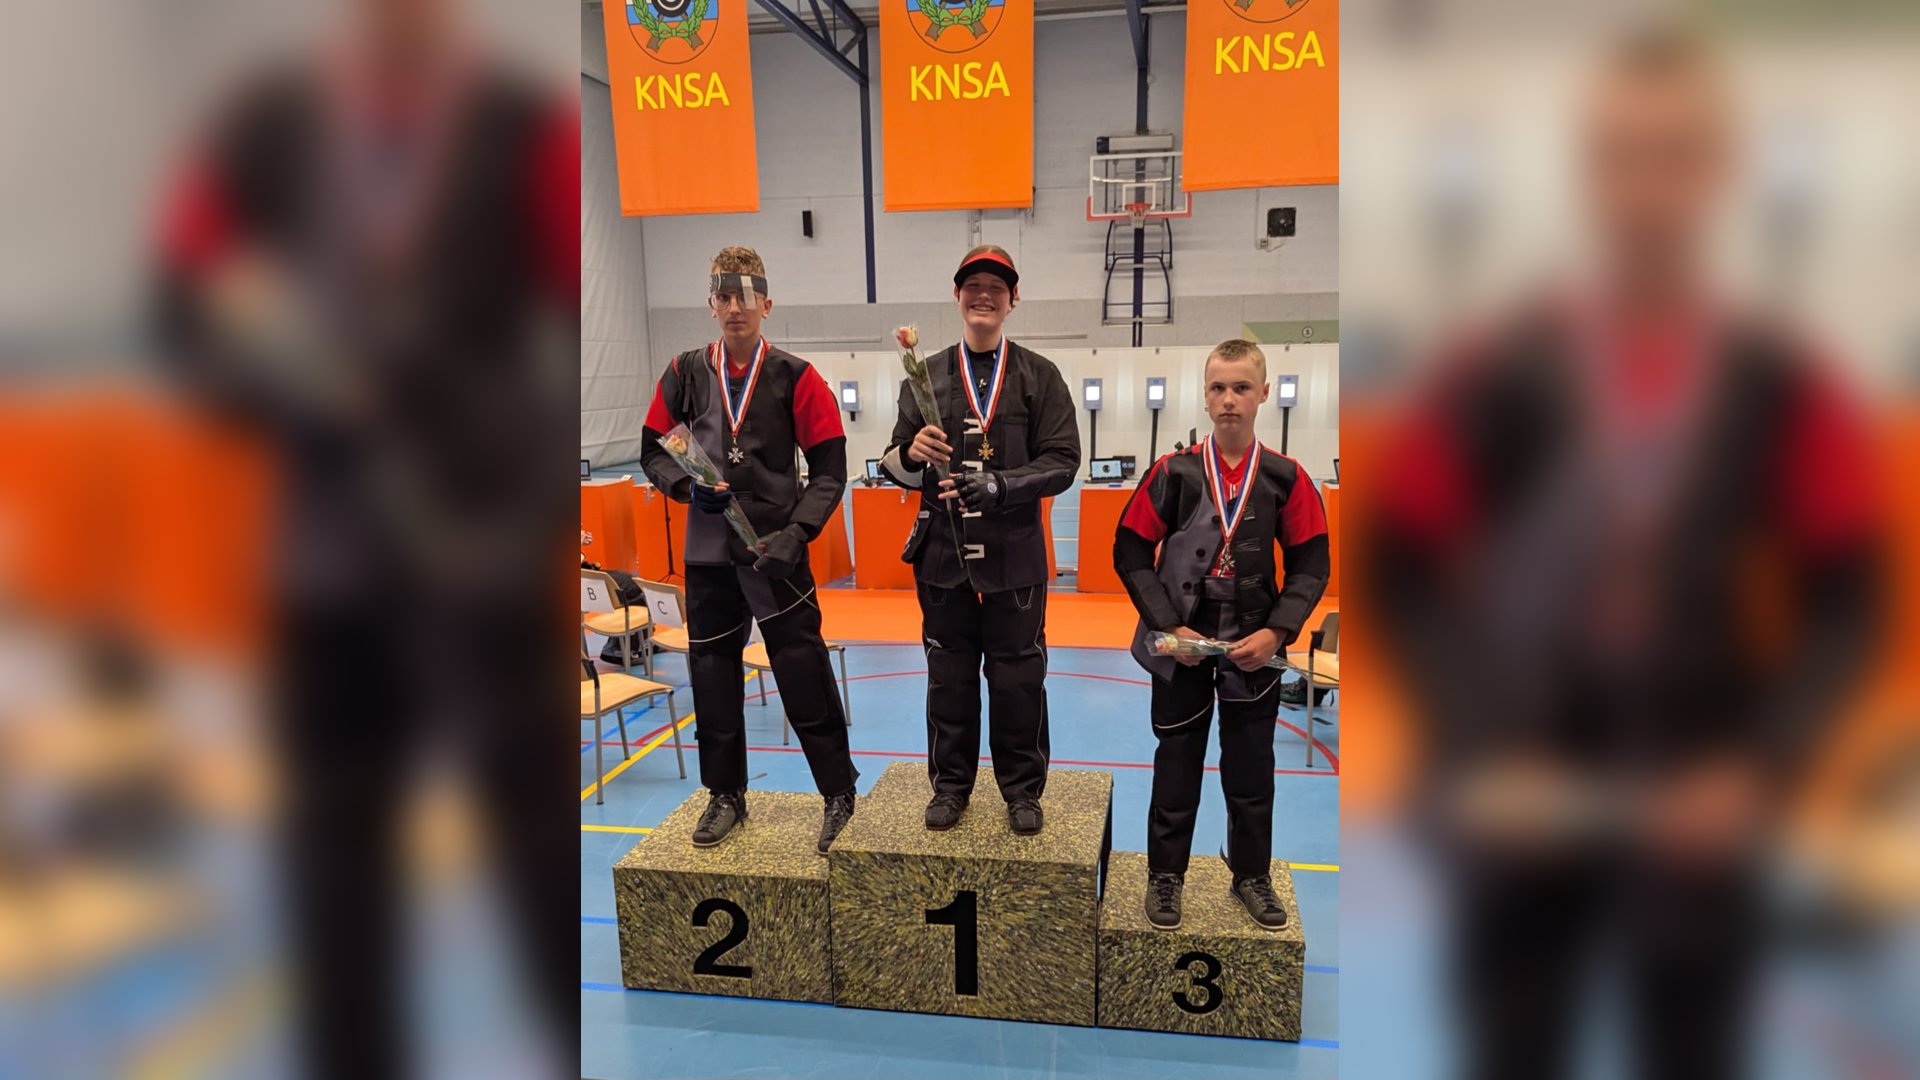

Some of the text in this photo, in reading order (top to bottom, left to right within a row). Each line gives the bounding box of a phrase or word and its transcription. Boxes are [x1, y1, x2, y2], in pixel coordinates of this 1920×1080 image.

[1215, 30, 1325, 75] KNSA
[635, 73, 731, 110] KNSA
[910, 61, 1010, 101] KNSA
[587, 587, 597, 601] B
[657, 601, 668, 615] C
[691, 897, 754, 979] 2
[924, 889, 979, 997] 1
[1171, 950, 1224, 1015] 3
